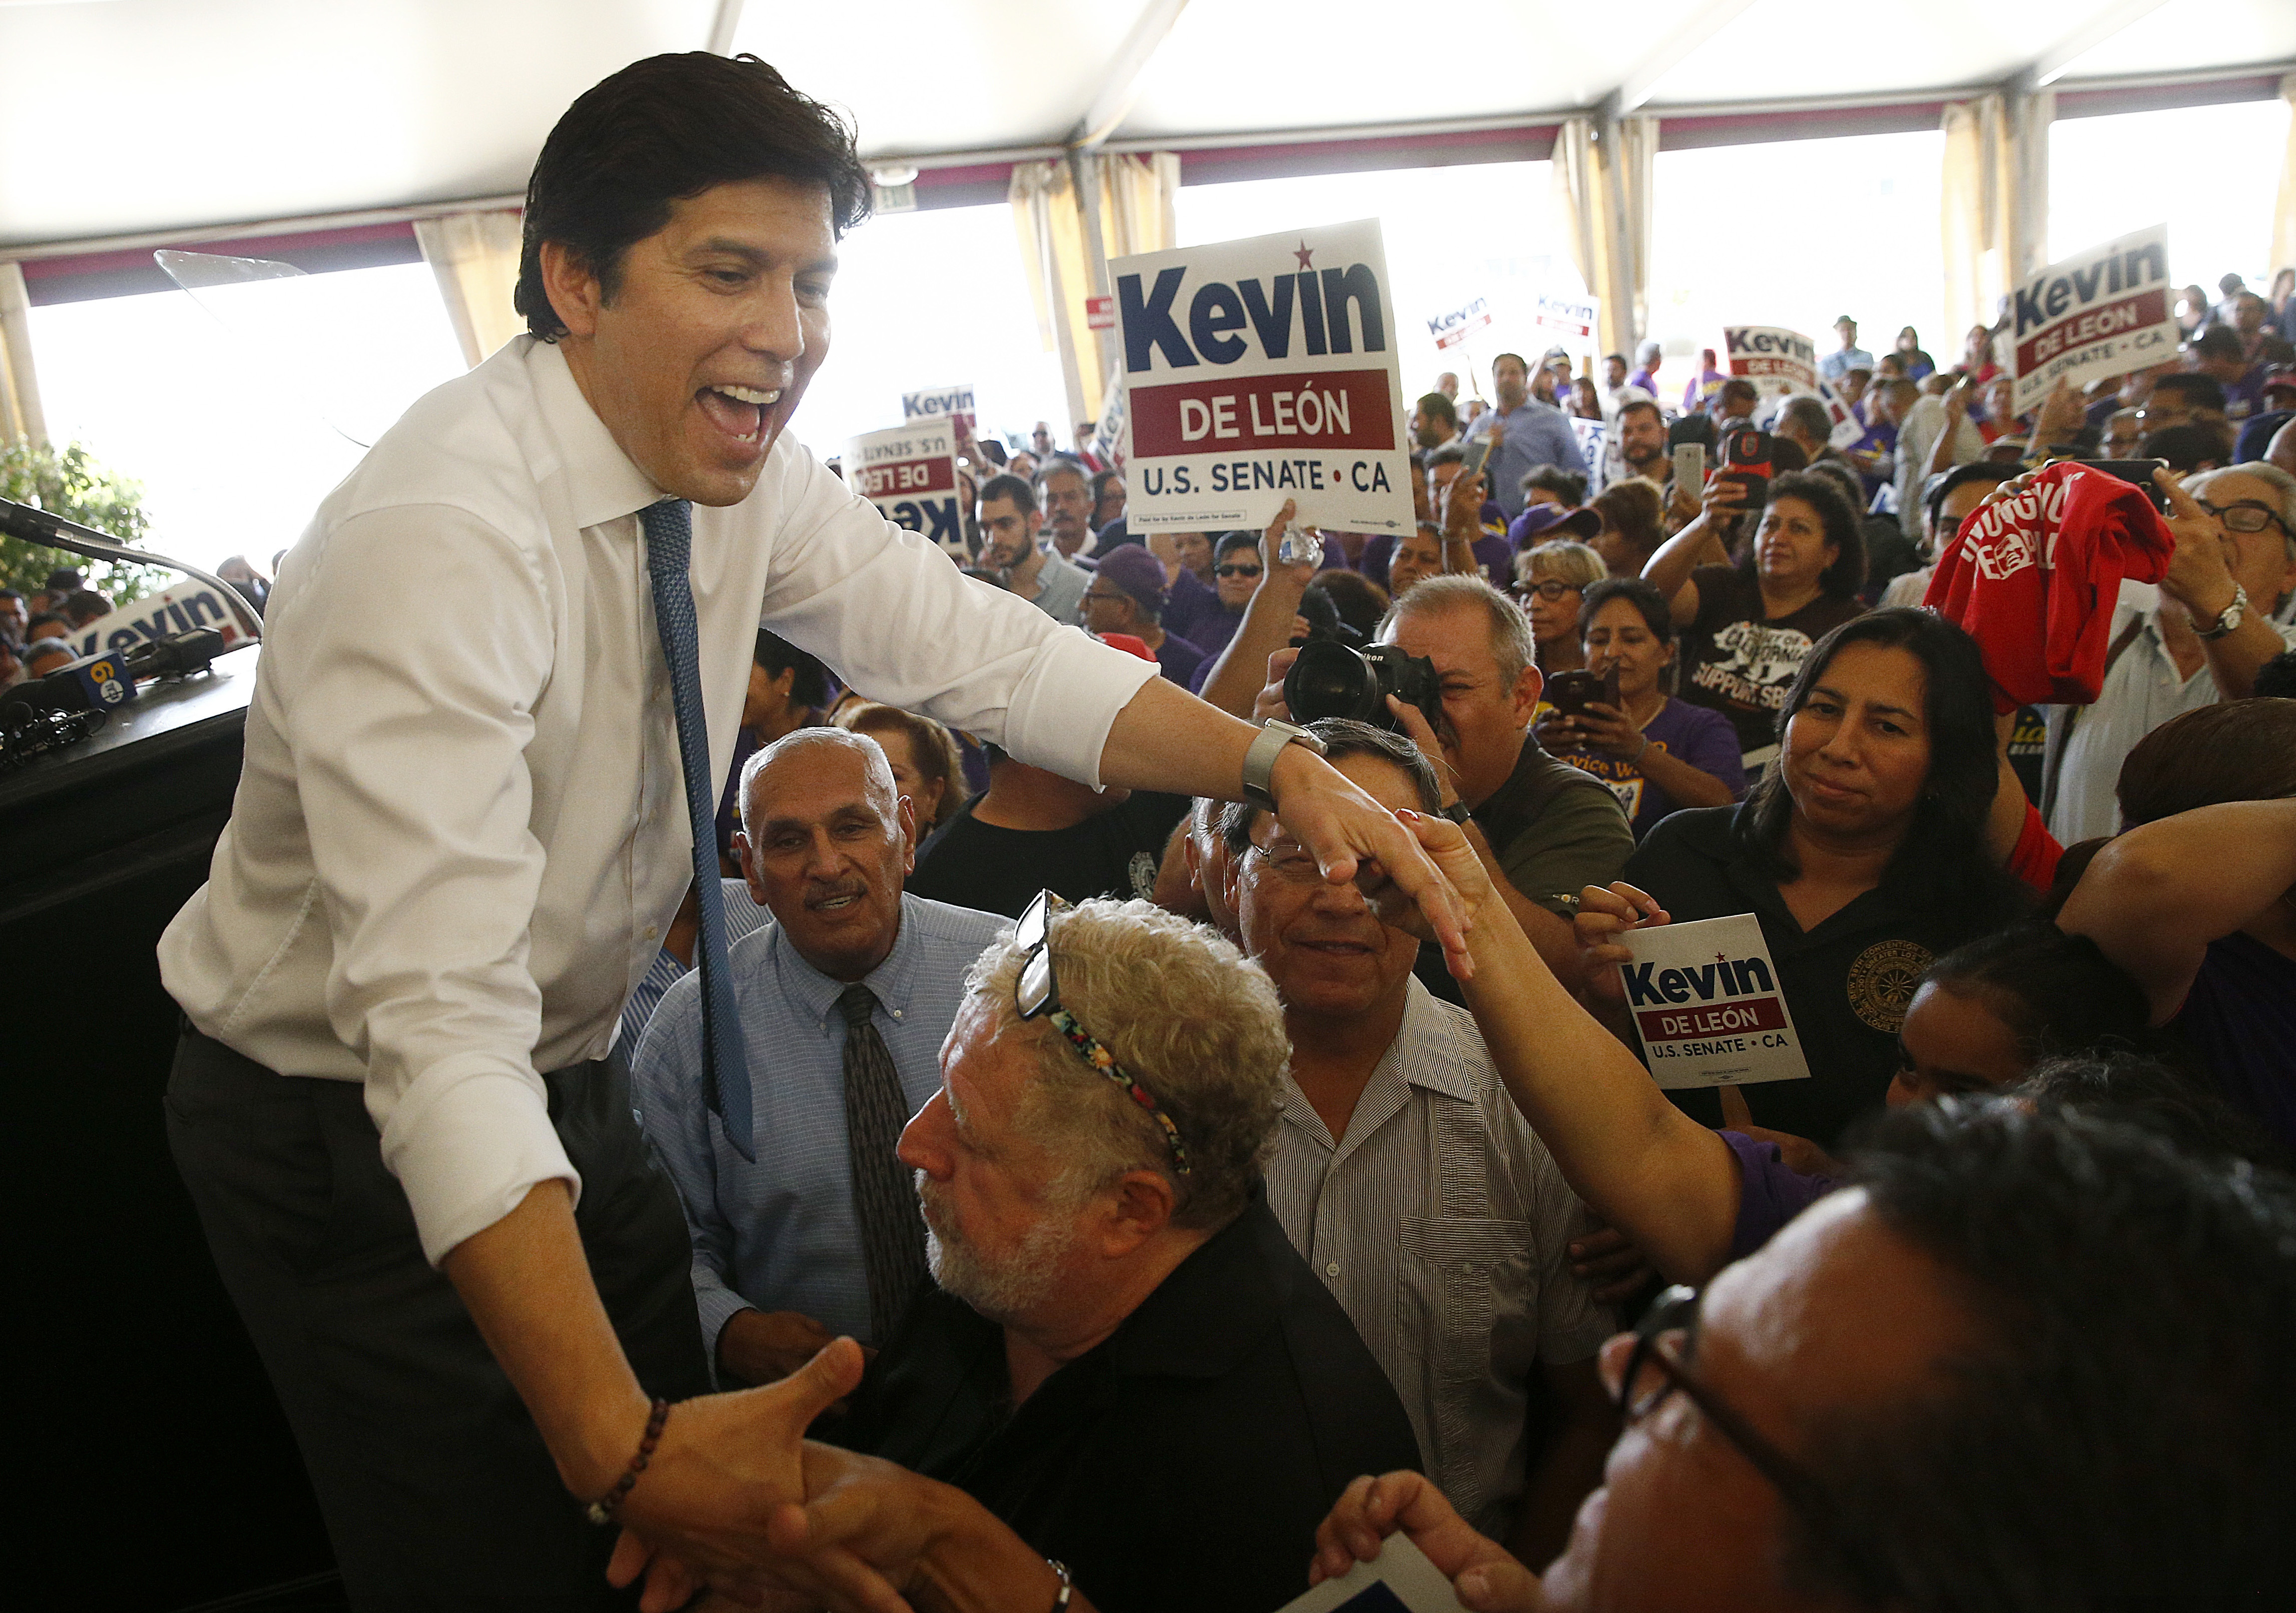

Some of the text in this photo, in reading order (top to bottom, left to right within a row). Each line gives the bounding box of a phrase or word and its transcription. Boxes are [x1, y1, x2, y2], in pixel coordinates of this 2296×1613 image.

[2014, 241, 2165, 337] Kevin
[1117, 262, 1386, 373] Kevin
[1179, 380, 1351, 442] DE LEÓN
[1144, 459, 1391, 496] U.S. SENATE CA
[1622, 956, 1774, 1007] Kevin
[1652, 1033, 1788, 1059] U.S. SENATE CA
[1661, 1006, 1759, 1035] DE LEÓN
